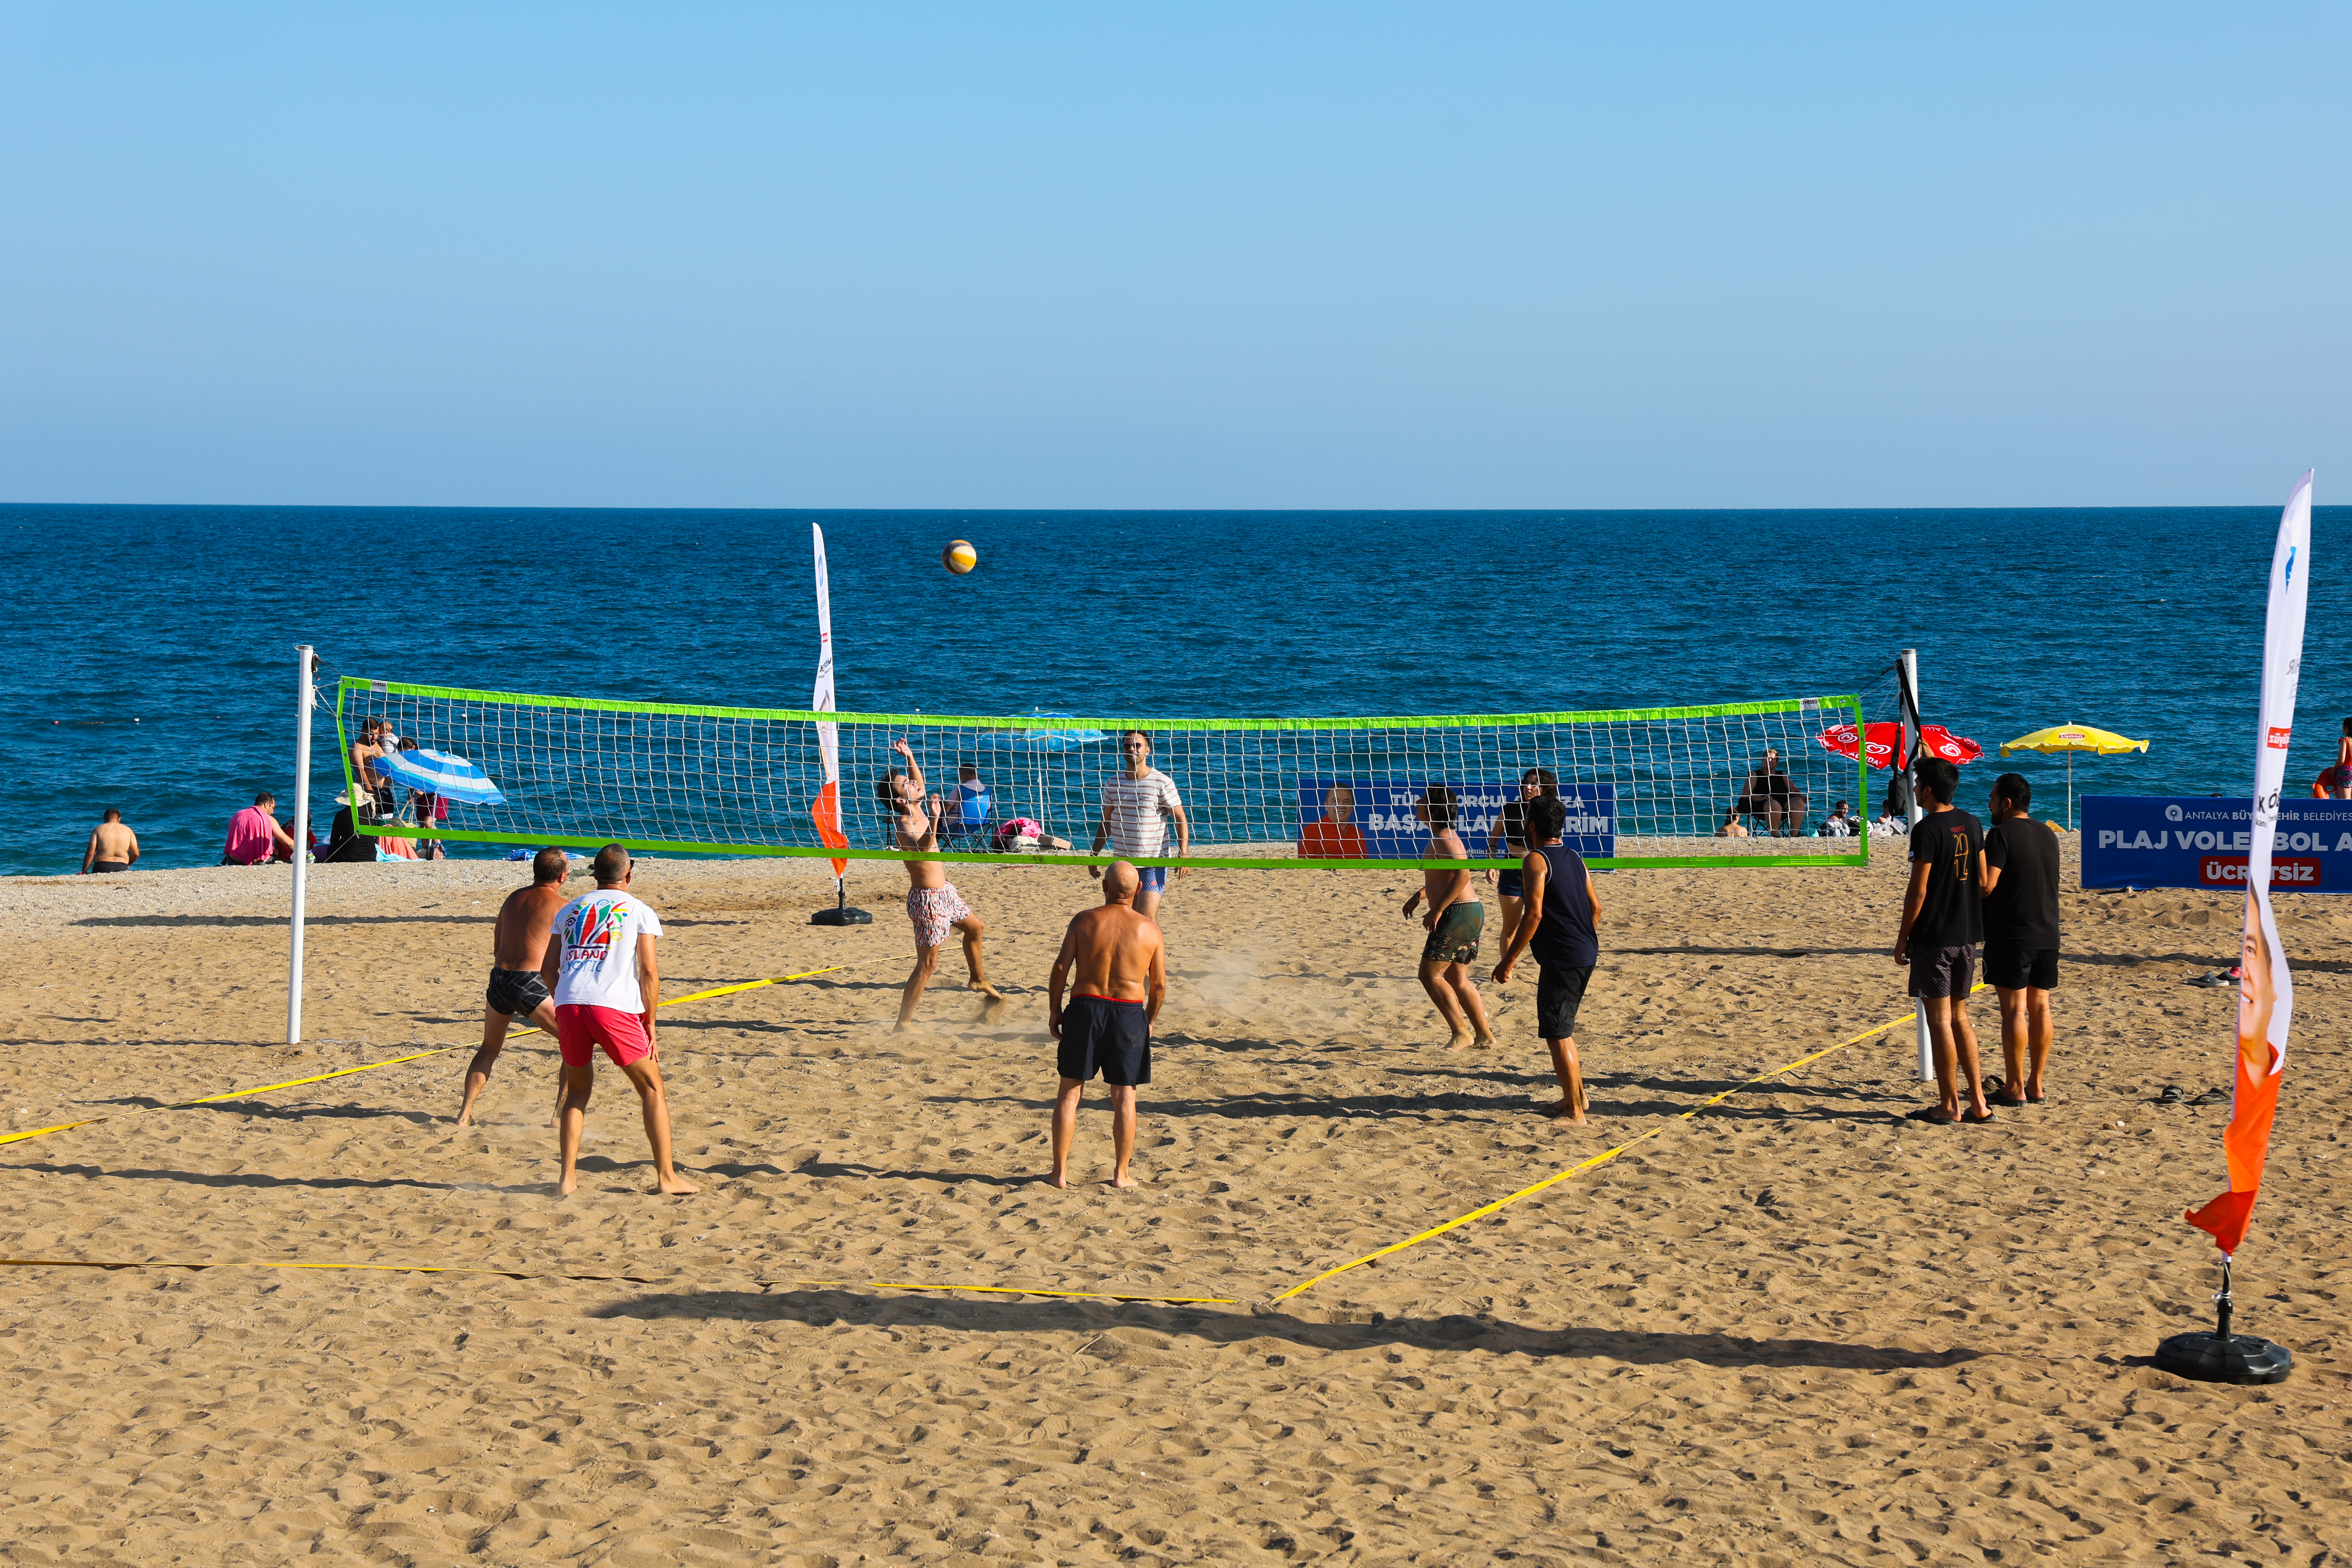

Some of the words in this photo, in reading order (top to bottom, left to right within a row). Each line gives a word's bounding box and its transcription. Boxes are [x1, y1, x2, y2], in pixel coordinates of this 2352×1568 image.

[1848, 753, 1878, 766] ALIDA
[2185, 811, 2229, 820] ANTALYA
[2232, 809, 2300, 821] BÜYEHİR
[2099, 830, 2167, 849] PLAJ
[2175, 831, 2328, 851] VOLEBOL
[2207, 862, 2314, 881] ÜCRTSİZ
[566, 949, 608, 961] ISLAND
